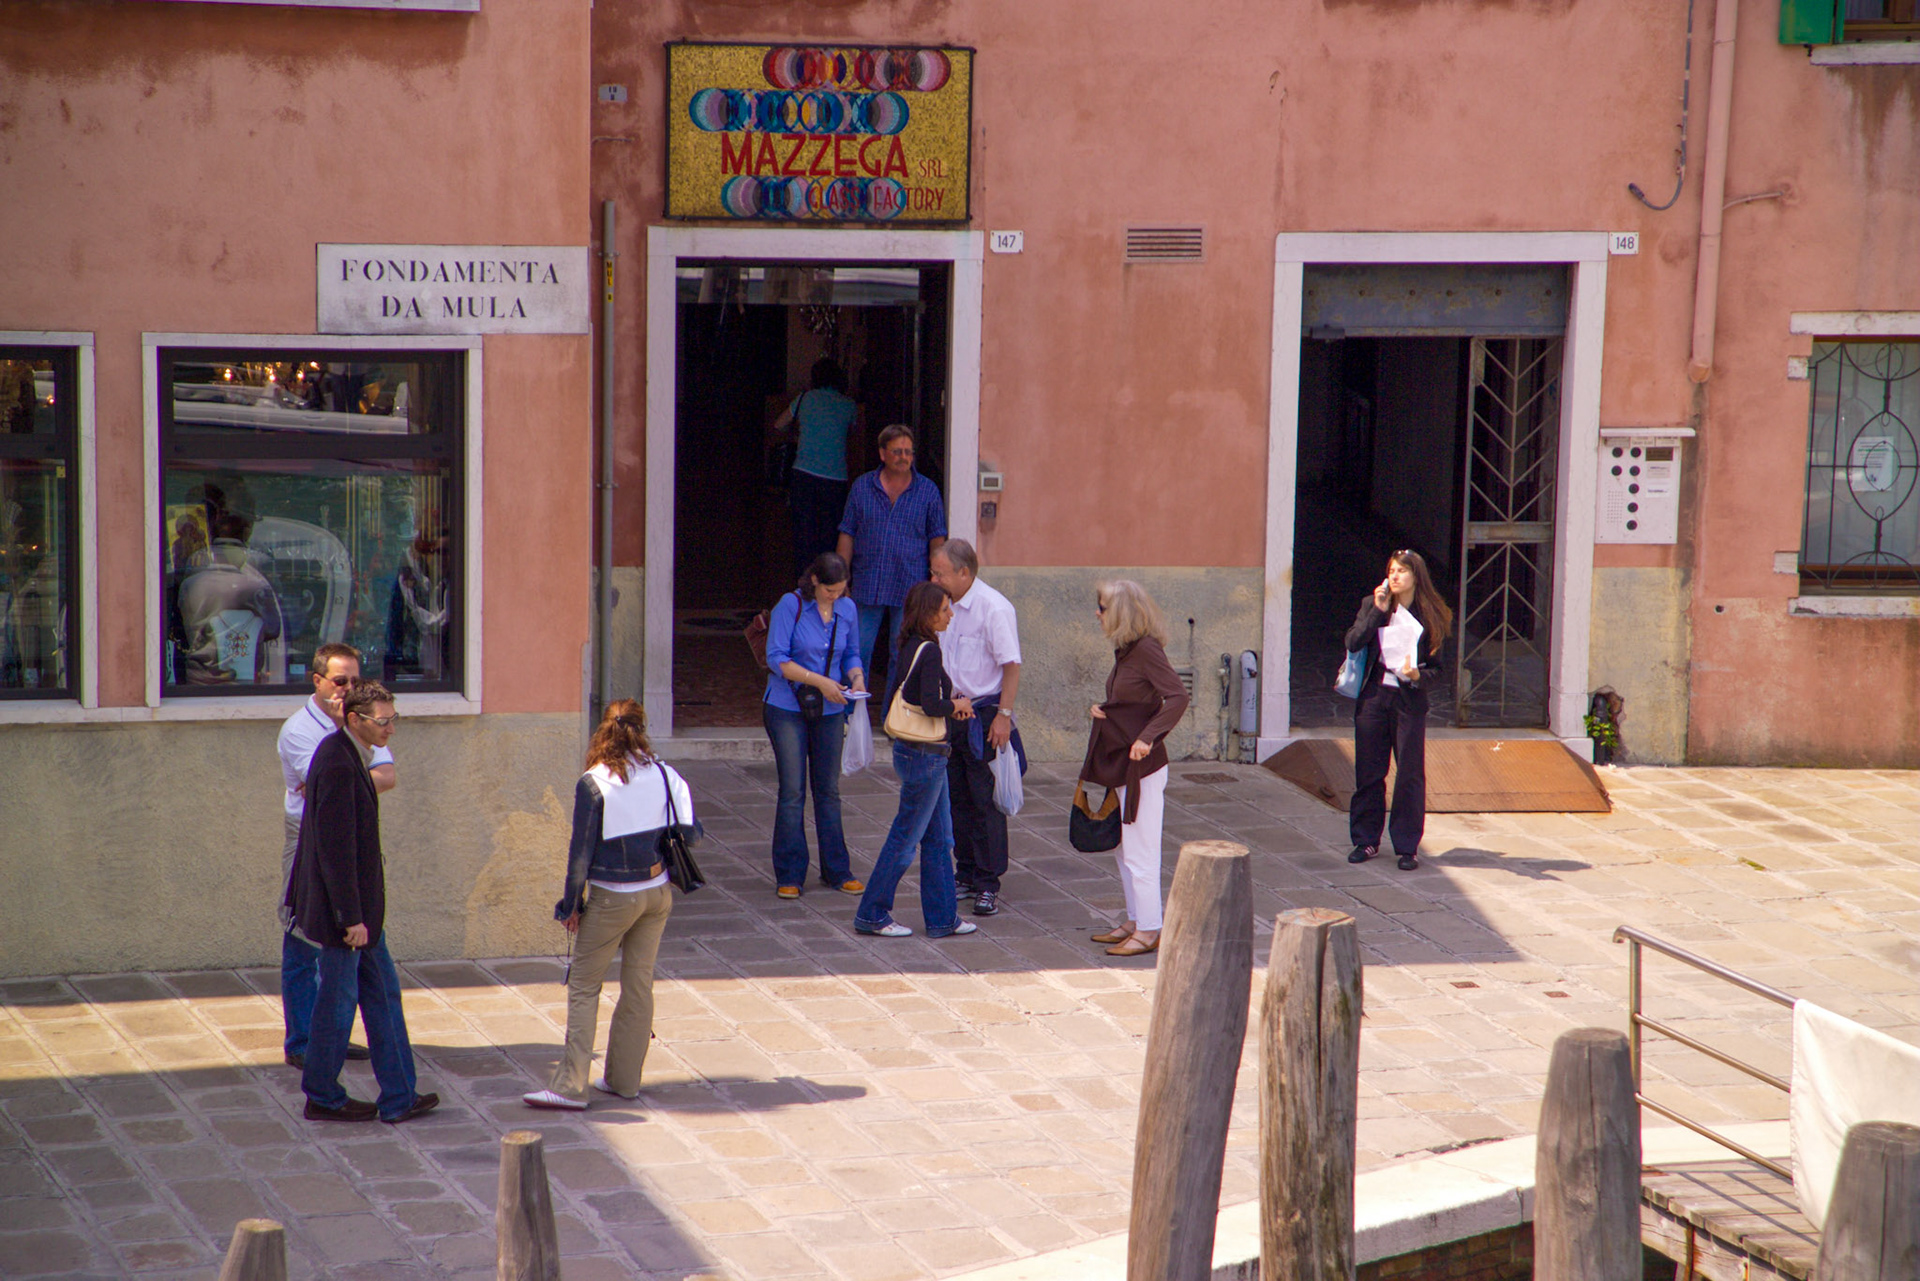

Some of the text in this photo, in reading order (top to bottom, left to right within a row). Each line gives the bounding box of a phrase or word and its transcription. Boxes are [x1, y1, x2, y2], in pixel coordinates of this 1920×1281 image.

[721, 132, 948, 179] MAZZEGA SRL
[808, 186, 946, 212] GLASS FACTORY
[997, 234, 1016, 249] 147
[1616, 236, 1635, 250] 148
[341, 258, 560, 285] FONDAMENTA
[381, 295, 527, 319] DA MULA
